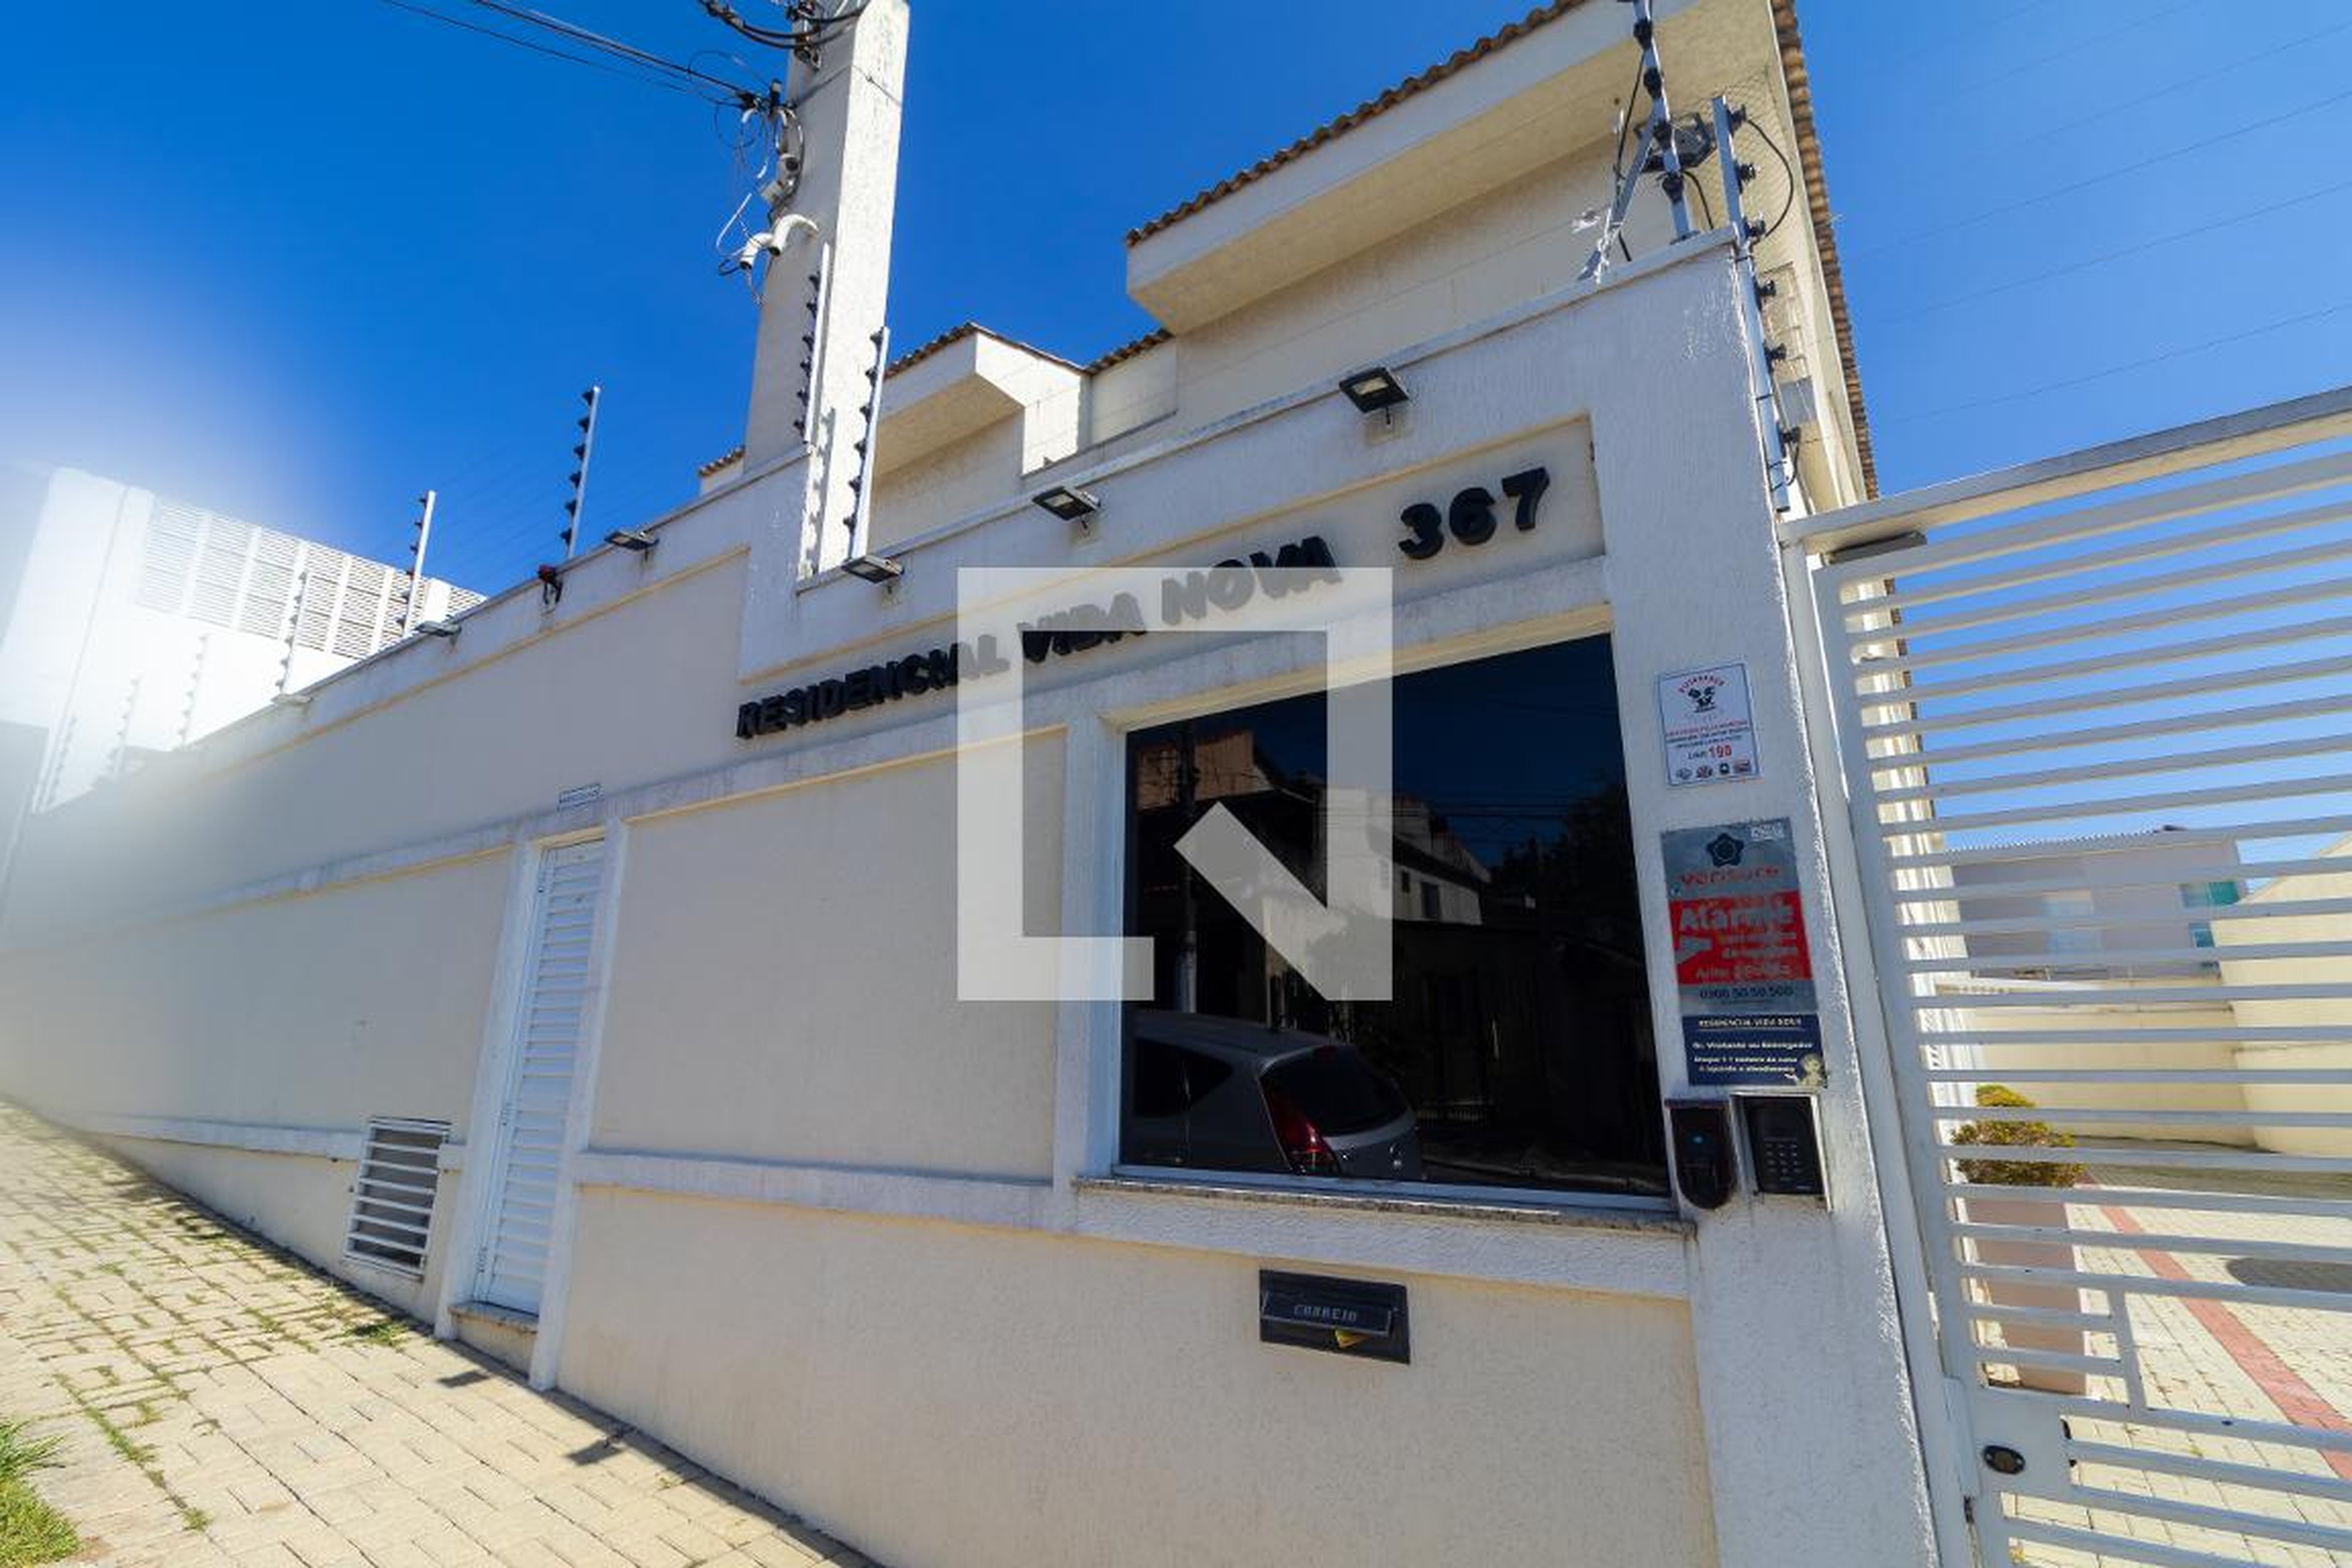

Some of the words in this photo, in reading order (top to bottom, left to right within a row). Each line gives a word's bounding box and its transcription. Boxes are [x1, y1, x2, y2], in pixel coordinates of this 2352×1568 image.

[736, 634, 1010, 739] RESIDENCIAL
[1017, 592, 1148, 663] VIDA
[1161, 536, 1343, 625] NOVA
[1398, 467, 1550, 560] 367
[1709, 745, 1732, 758] 190
[1294, 1303, 1357, 1323] CORREIO
